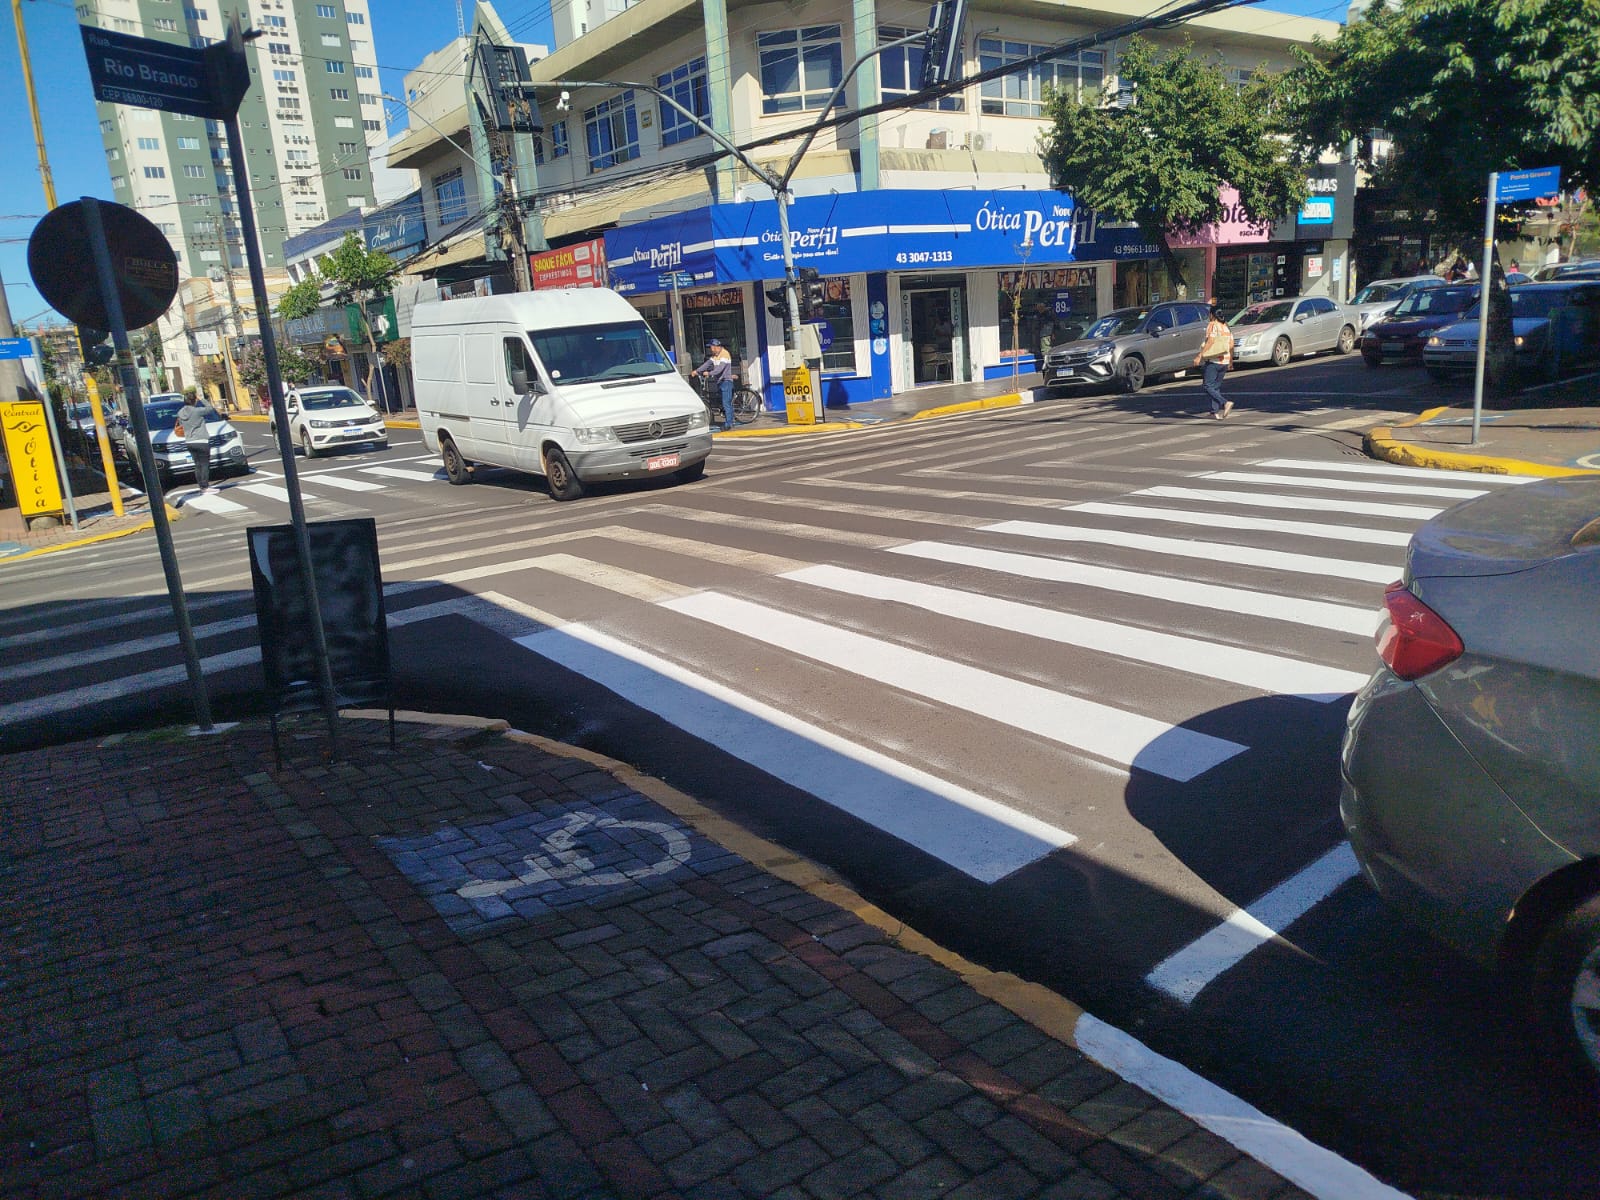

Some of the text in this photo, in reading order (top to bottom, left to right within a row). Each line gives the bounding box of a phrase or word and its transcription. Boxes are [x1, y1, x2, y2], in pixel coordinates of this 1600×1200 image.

[88, 33, 111, 47] Rua
[103, 57, 199, 89] Rio Branco
[102, 88, 120, 100] CEP
[976, 201, 1097, 254] Ótica Perfil
[762, 226, 838, 250] Ótic Perfil
[633, 241, 682, 270] Ótica Perfil
[896, 251, 953, 263] 43 3047-1313
[1114, 245, 1122, 255] 43
[534, 255, 556, 272] SAQUE
[556, 251, 575, 268] FÁCIL
[785, 385, 810, 395] OURO
[4, 408, 41, 418] Central
[24, 437, 47, 508] Ótica
